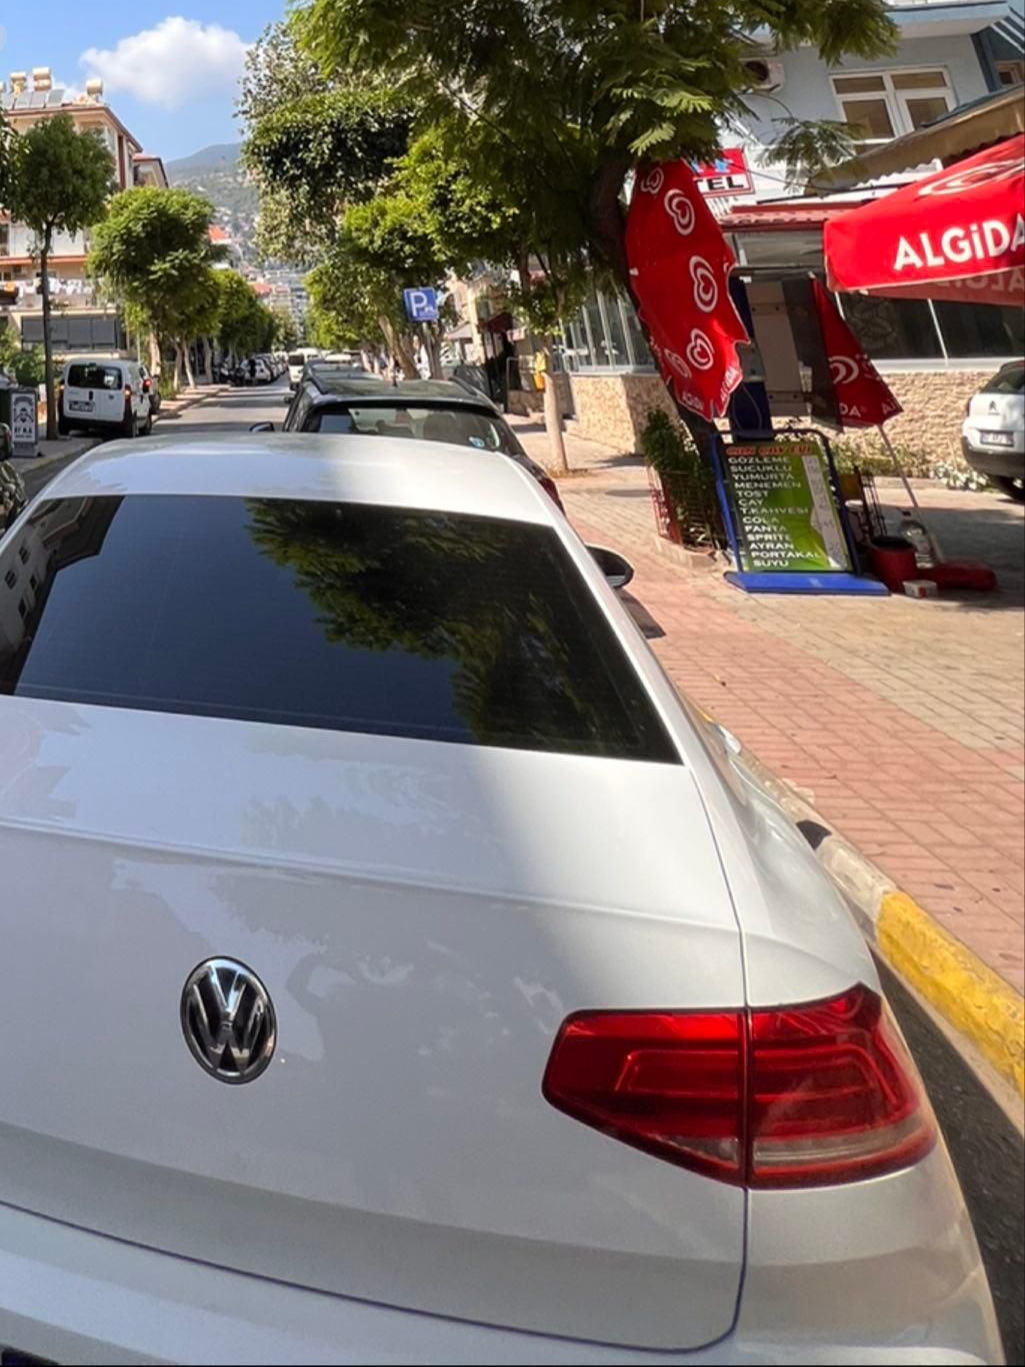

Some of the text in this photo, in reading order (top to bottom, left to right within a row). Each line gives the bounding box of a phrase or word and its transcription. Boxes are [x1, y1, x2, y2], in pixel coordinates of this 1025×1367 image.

[409, 291, 428, 318] P
[742, 516, 779, 524] COLA
[750, 542, 794, 550] AYRAN
